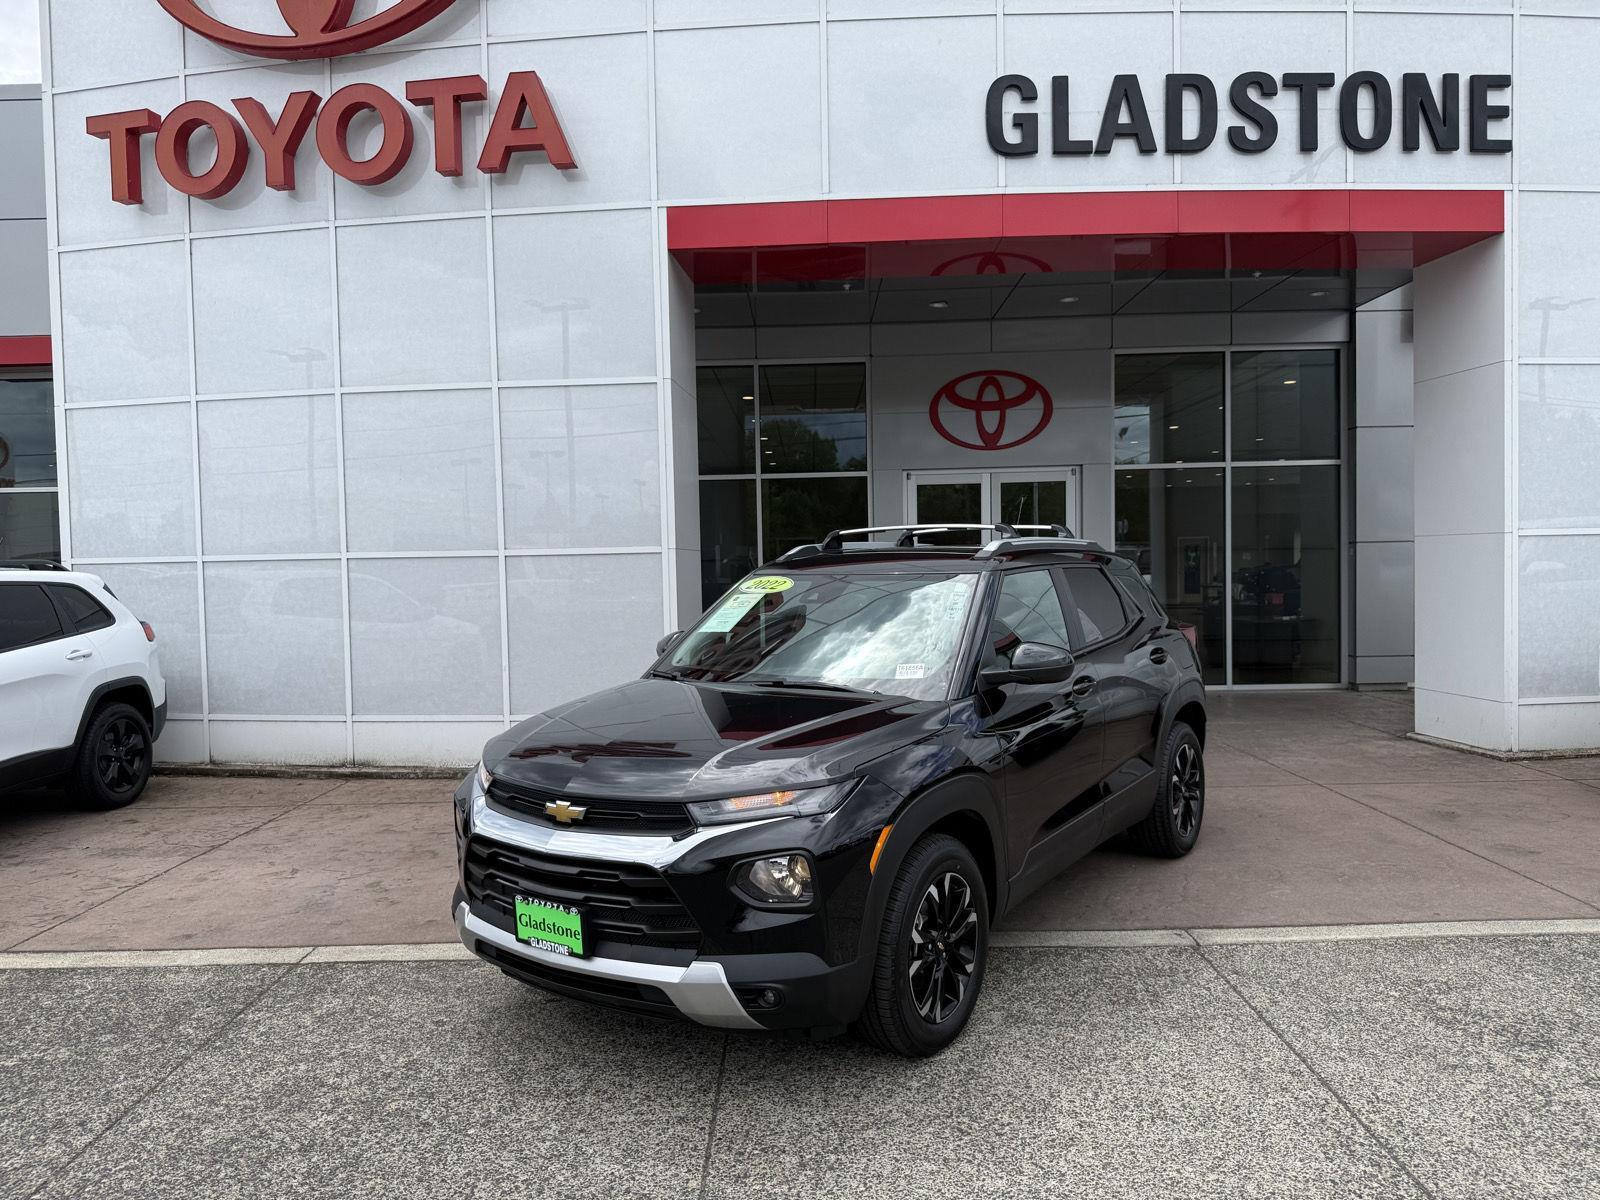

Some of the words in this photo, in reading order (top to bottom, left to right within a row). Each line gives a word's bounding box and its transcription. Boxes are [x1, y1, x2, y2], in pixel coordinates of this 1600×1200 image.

[985, 70, 1513, 156] GLADSTONE
[86, 70, 578, 206] TOYOTA
[745, 579, 788, 590] 2022
[528, 897, 565, 912] TOYOTA
[518, 913, 581, 941] Gladstone
[530, 937, 569, 956] GLADSTONE
